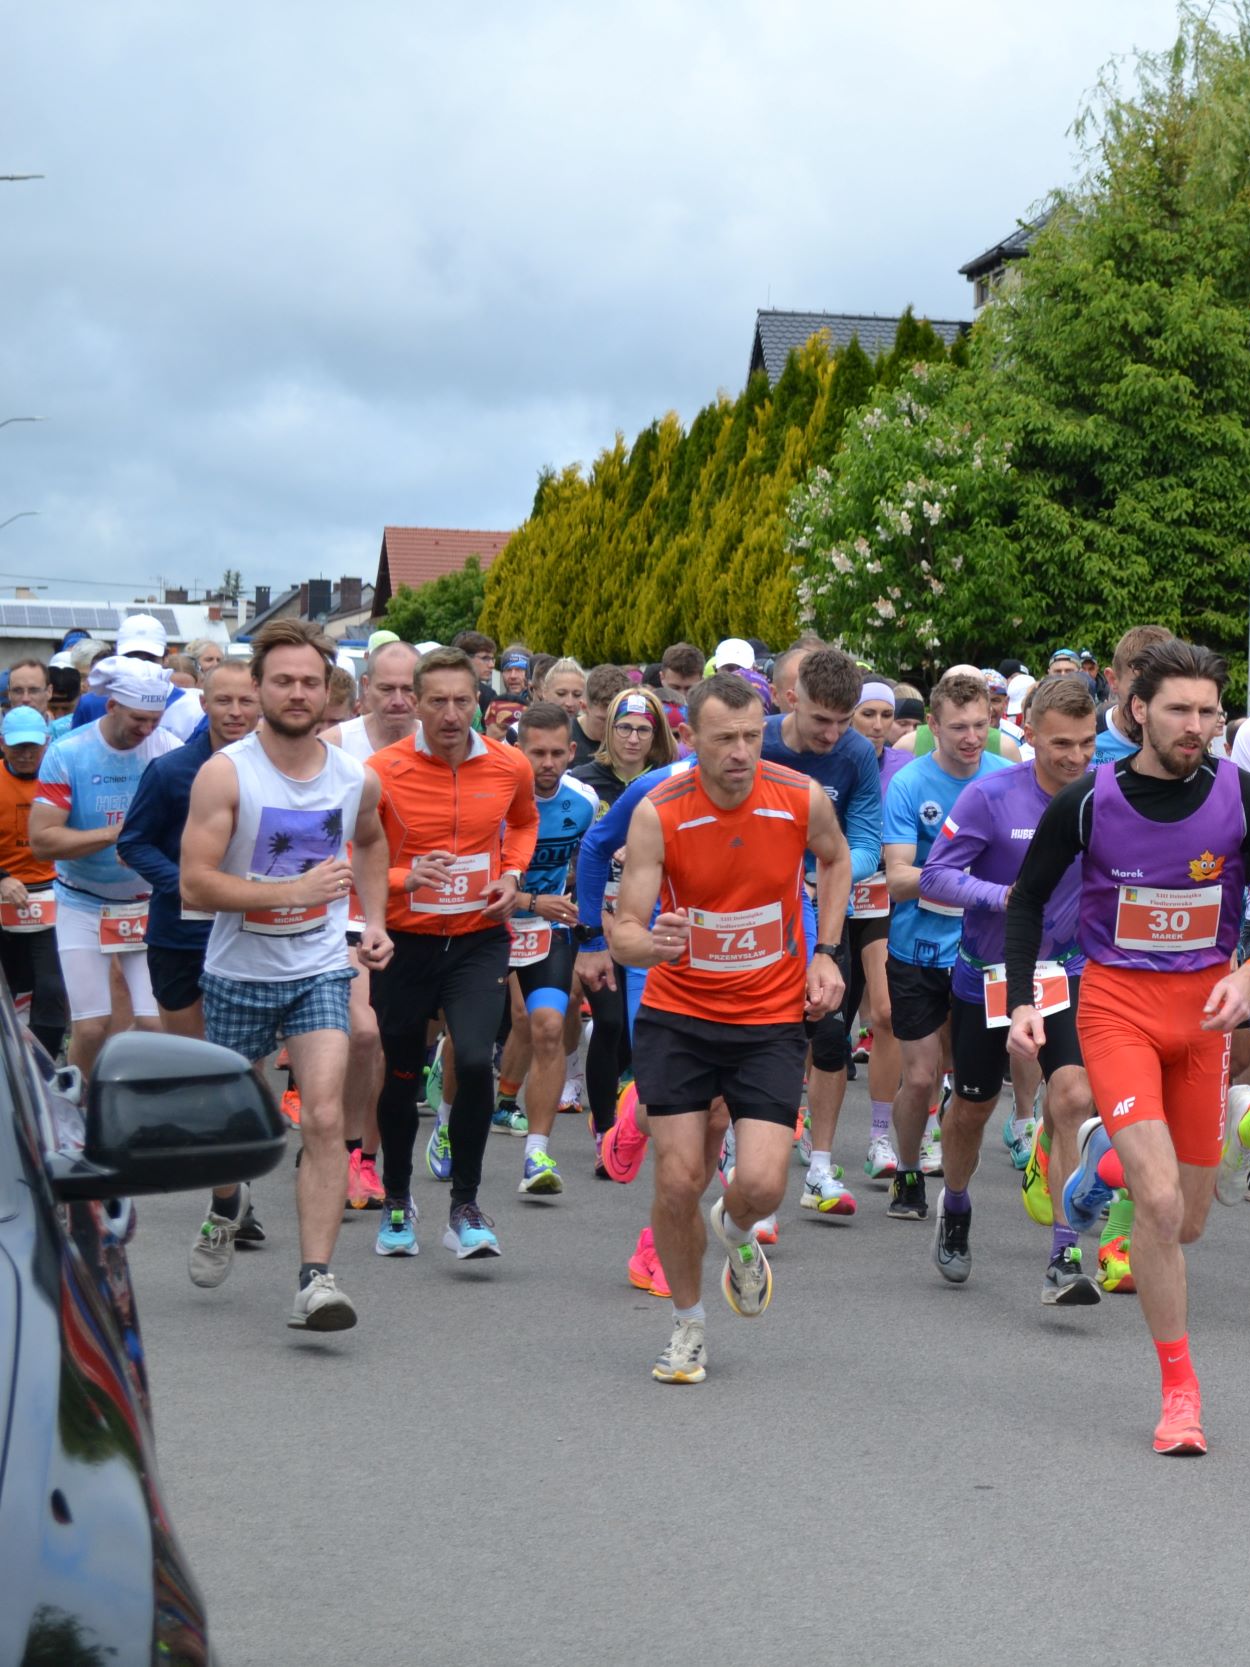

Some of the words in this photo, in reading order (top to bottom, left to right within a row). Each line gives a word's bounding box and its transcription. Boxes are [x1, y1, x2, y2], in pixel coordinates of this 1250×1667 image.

[1111, 868, 1144, 878] Marek
[118, 919, 145, 937] 84
[1148, 910, 1190, 932] 30
[716, 930, 757, 953] 74
[1151, 932, 1184, 940] MAREK
[709, 949, 766, 961] PRZEMYSŁAW
[1113, 1096, 1136, 1117] 4F
